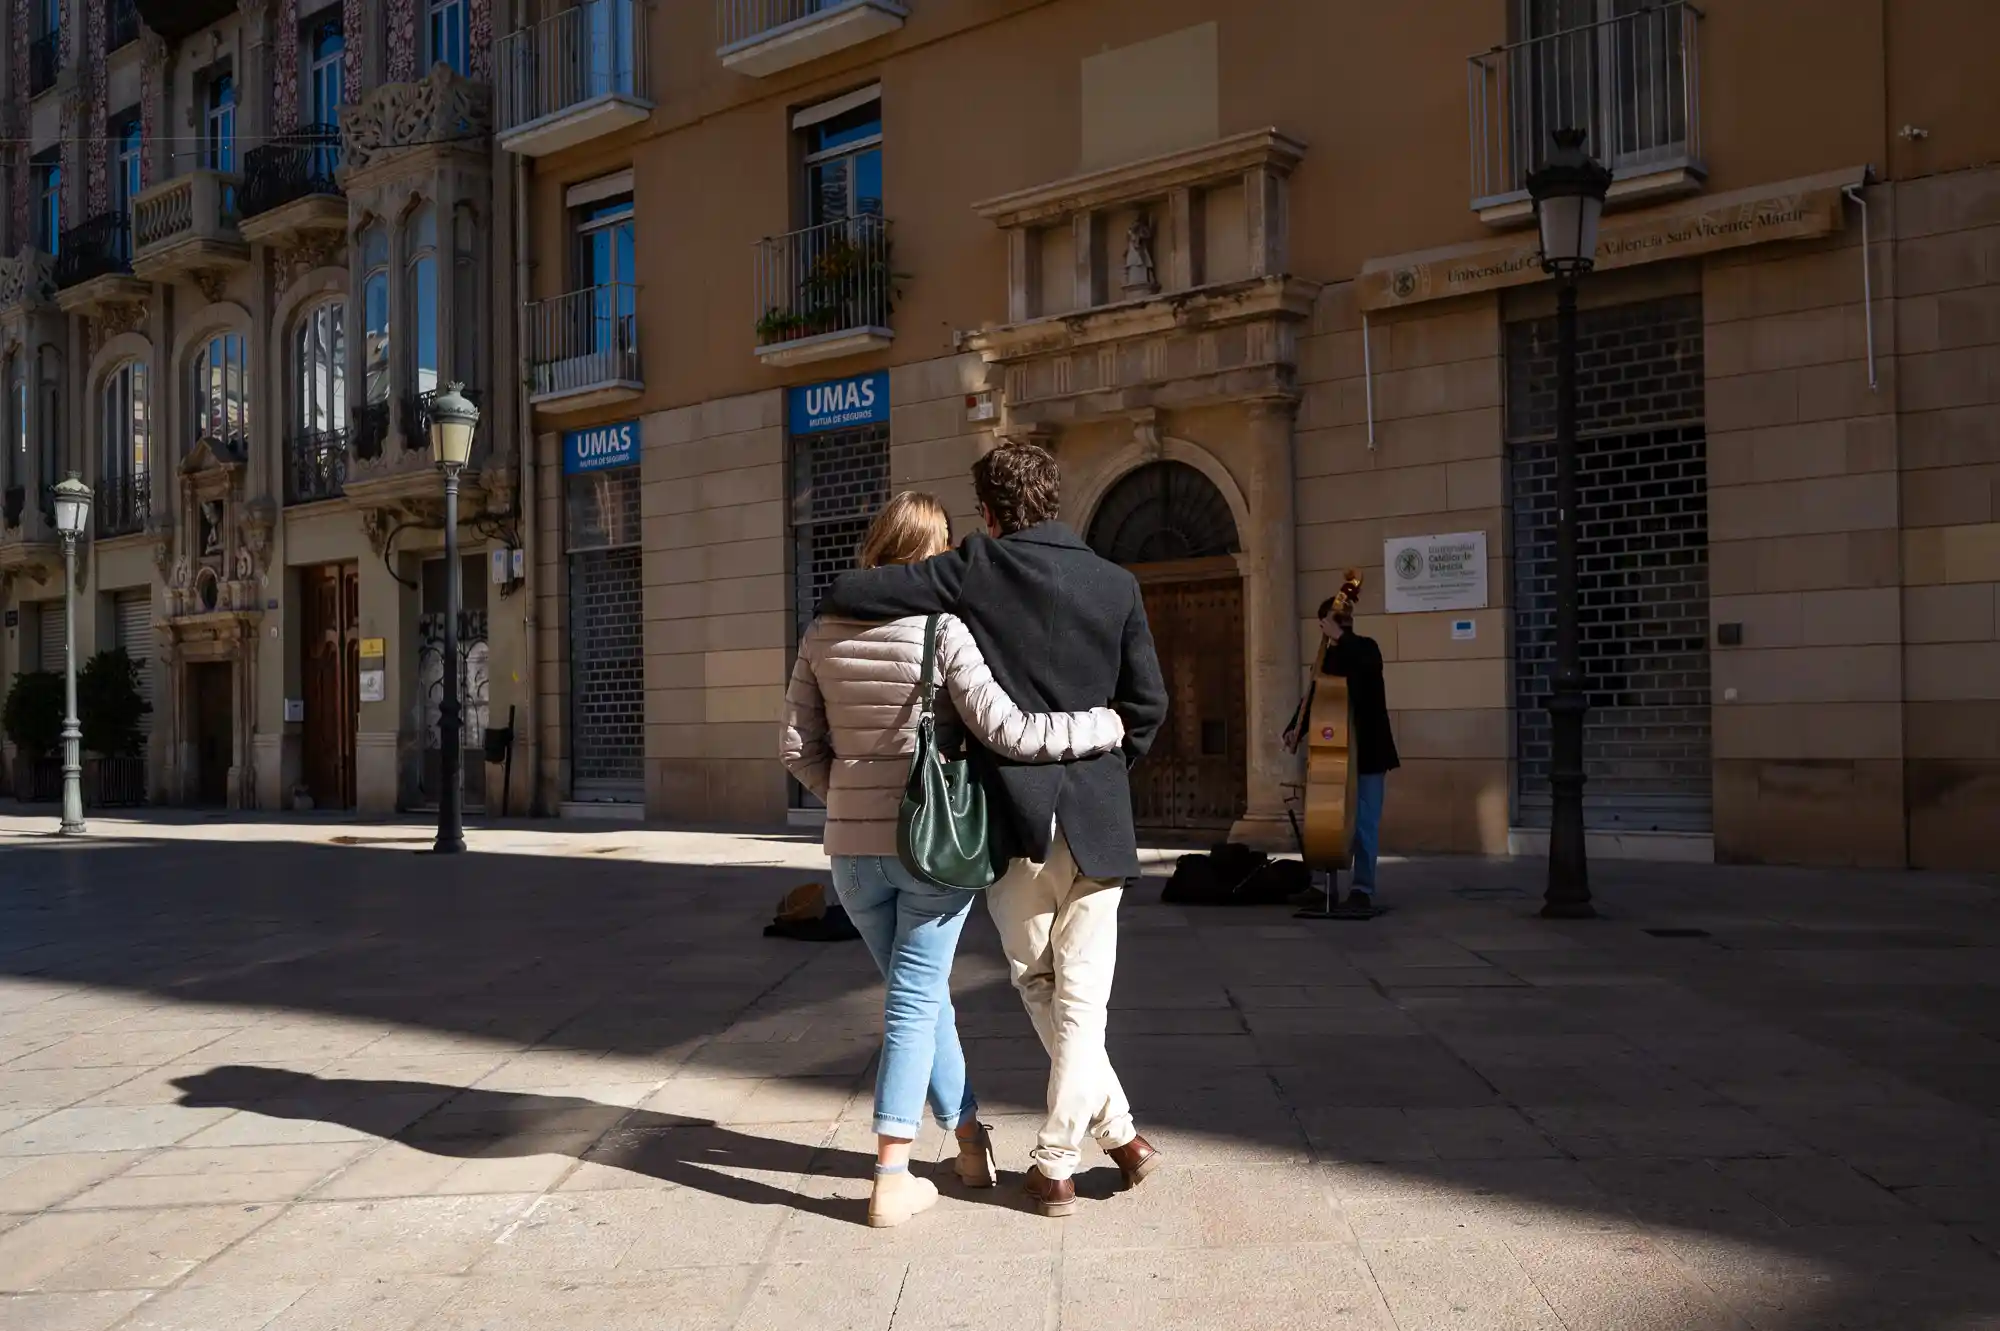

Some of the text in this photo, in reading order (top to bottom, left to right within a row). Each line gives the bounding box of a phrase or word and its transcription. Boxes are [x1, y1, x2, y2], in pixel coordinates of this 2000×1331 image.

[1667, 230, 1692, 243] San
[1696, 219, 1754, 237] Vicente
[806, 379, 875, 415] UMAS
[809, 409, 873, 428] MUTUA DE SEGUROS
[577, 426, 631, 458] UMAS
